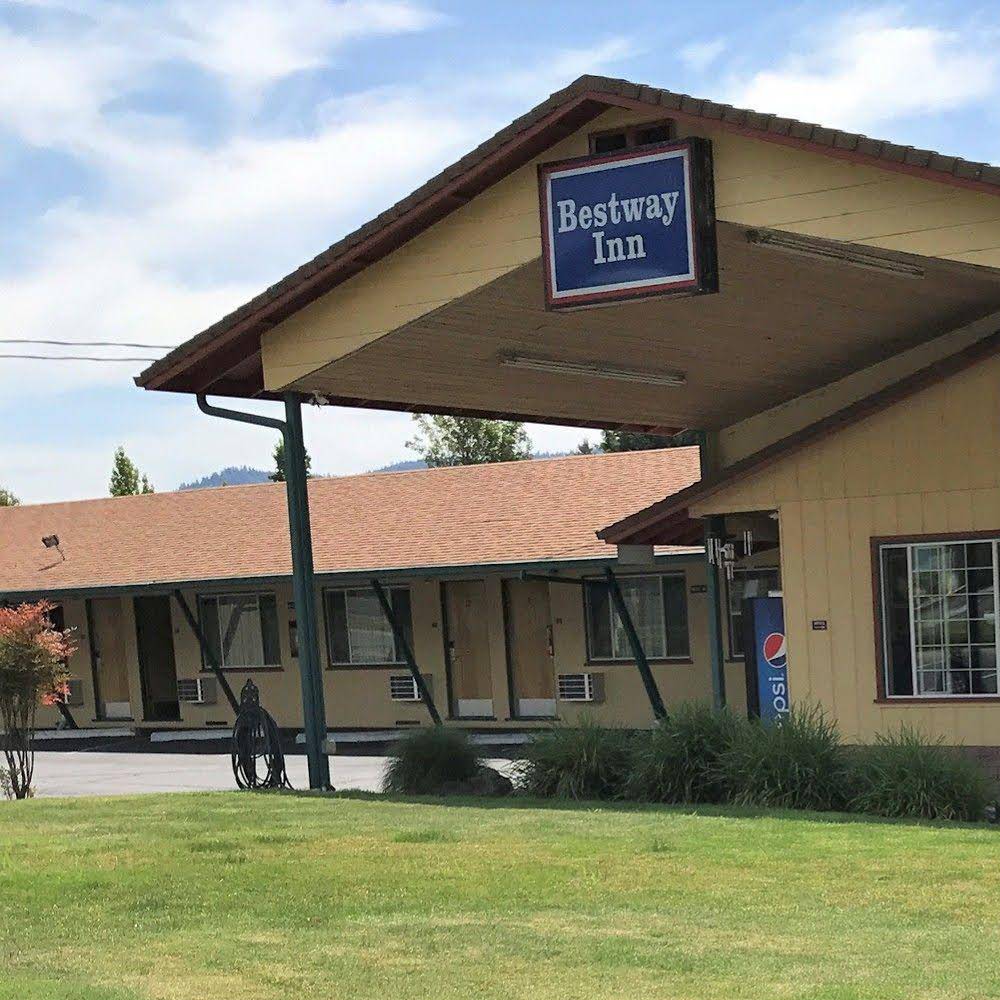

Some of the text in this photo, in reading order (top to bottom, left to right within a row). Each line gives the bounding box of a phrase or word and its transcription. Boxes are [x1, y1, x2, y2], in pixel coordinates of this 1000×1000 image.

[557, 192, 680, 233] Bestway
[592, 230, 647, 265] Inn
[768, 676, 790, 728] psi
